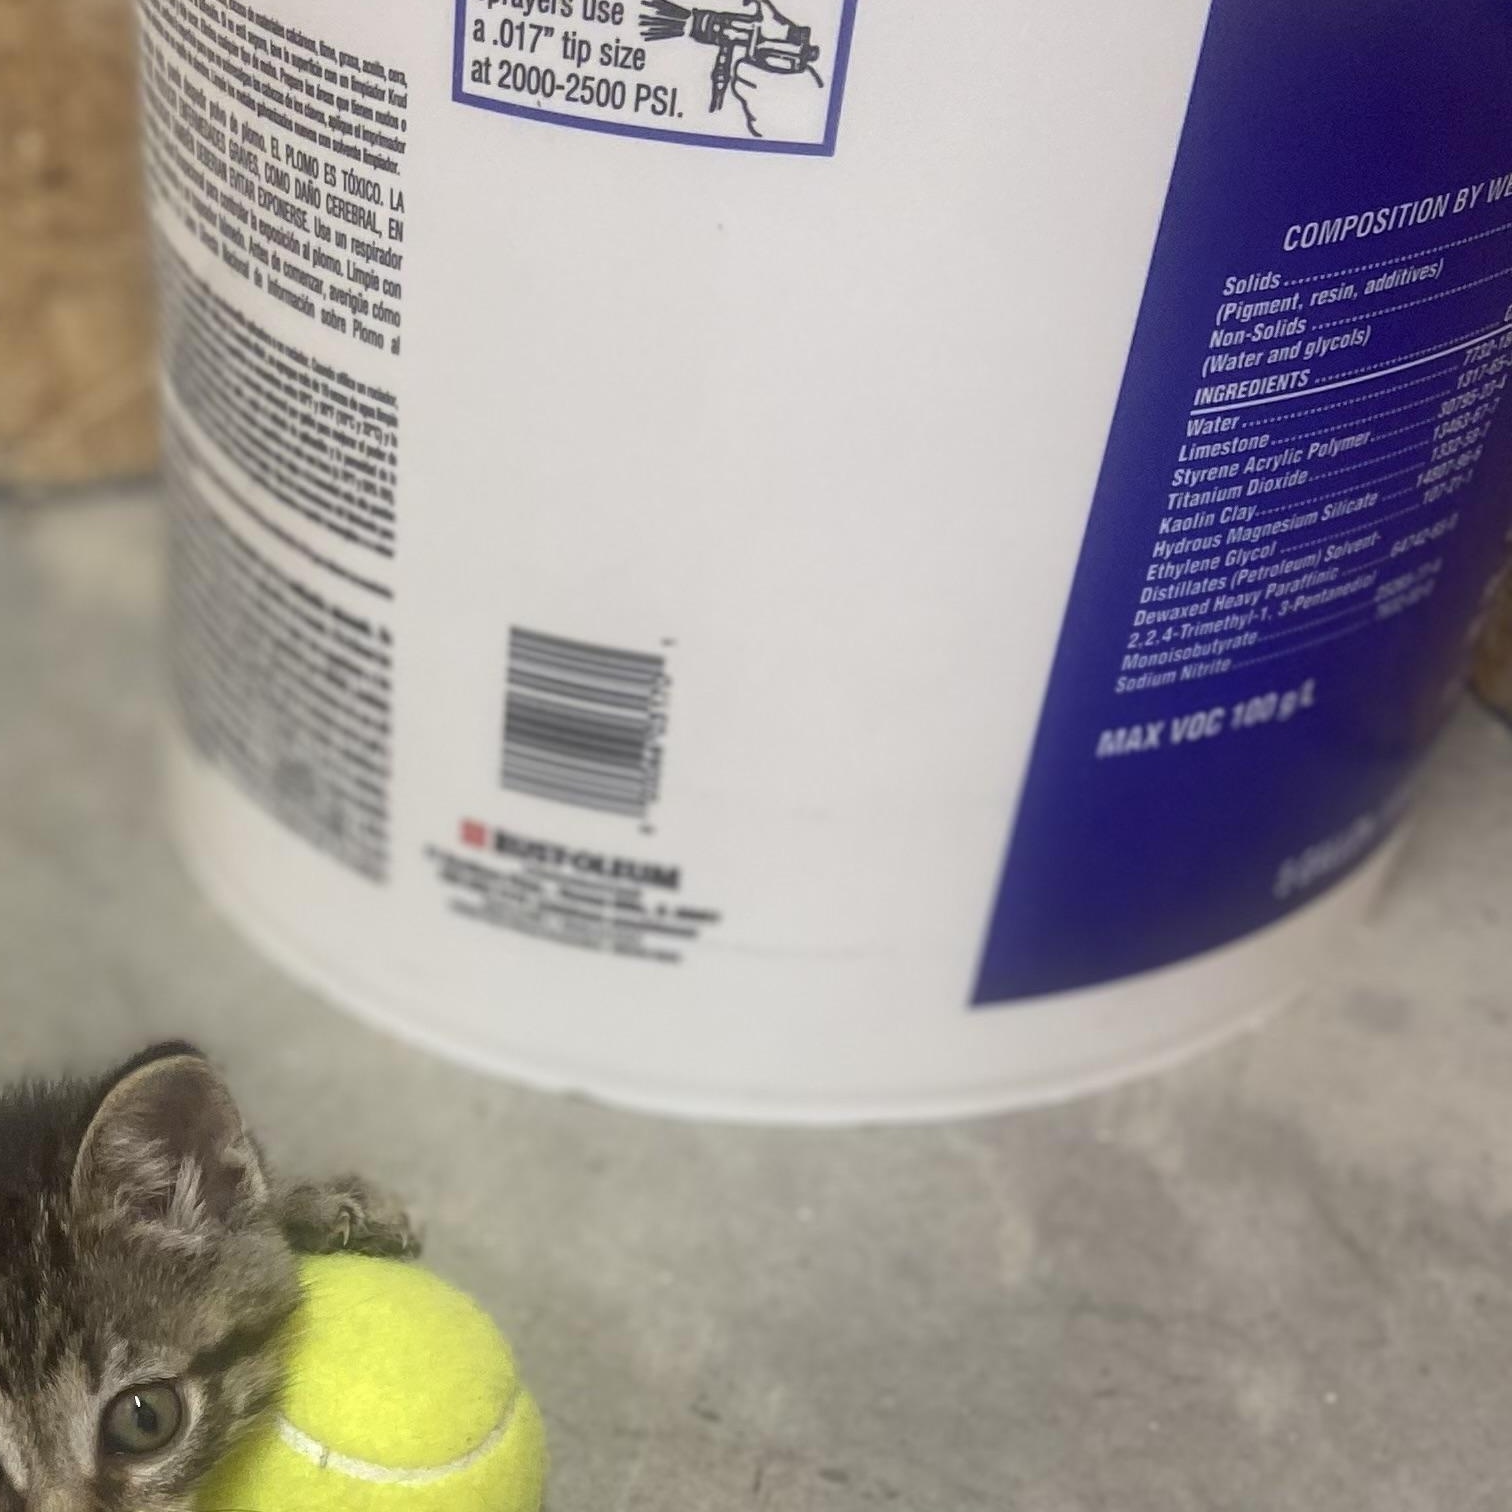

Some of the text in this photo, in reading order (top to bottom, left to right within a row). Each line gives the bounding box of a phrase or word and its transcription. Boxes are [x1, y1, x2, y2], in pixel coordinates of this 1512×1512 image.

[583, 0, 624, 25] use
[473, 18, 485, 43] a
[562, 31, 592, 68] tip
[600, 38, 646, 71] size
[471, 56, 684, 118] at 2000-2500 PSI.
[400, 118, 408, 133] o
[271, 136, 281, 162] EL
[285, 143, 319, 180] PLOMO
[324, 162, 336, 188] ES
[341, 168, 383, 207] TÓXICO.
[390, 187, 405, 214] LA
[265, 161, 291, 195] COMO
[294, 178, 321, 210] DAÑO
[326, 192, 383, 240] CEREBRAL,
[388, 217, 404, 243] EN
[1283, 193, 1450, 251] COMPOSITION
[1453, 182, 1485, 213] BY
[314, 215, 331, 243] Use
[334, 230, 347, 250] un
[351, 237, 403, 271] respirador
[283, 261, 326, 301] comenzar,
[329, 283, 369, 315] averigüe
[372, 301, 401, 328] cómo
[302, 240, 310, 261] al
[312, 246, 344, 277] plomo.
[347, 259, 379, 292] Limpie
[382, 279, 401, 299] con
[1216, 258, 1444, 326] (Pigment, resin, additives)
[1223, 271, 1282, 297] Solids
[321, 308, 346, 334] sobre
[353, 317, 384, 349] Plomo
[391, 336, 401, 355] al
[1202, 325, 1372, 378] (Water and glycols)
[1209, 317, 1307, 349] Non-Solids
[1194, 368, 1311, 406] INGREDIENTS
[1178, 432, 1270, 463] Limestone
[1187, 415, 1240, 438] Water
[1172, 462, 1239, 488] Styrene
[1243, 447, 1303, 474] Acrylic
[1307, 430, 1372, 461] Polymer
[1168, 484, 1243, 510] Titanium
[1246, 468, 1309, 497] Dioxide
[1152, 533, 1222, 558] Hydrous
[1226, 511, 1318, 545] Magnesium
[1321, 491, 1378, 521] Silicate
[1159, 511, 1215, 534] Kaolin
[1220, 503, 1258, 524] Clay
[1140, 577, 1226, 604] Distillates
[1231, 552, 1322, 590] (Petroleum)
[1146, 555, 1220, 582] Ethylene
[1224, 541, 1277, 568] Glycol
[1133, 597, 1210, 627] Dewaxed
[1213, 586, 1262, 612] Heavy
[1265, 567, 1339, 599] Paraffinic
[1114, 657, 1232, 694] Sodium Nitrite
[1122, 631, 1259, 671] Monoisobutyrate
[1096, 720, 1165, 759] MAX
[1170, 706, 1226, 745] VOC
